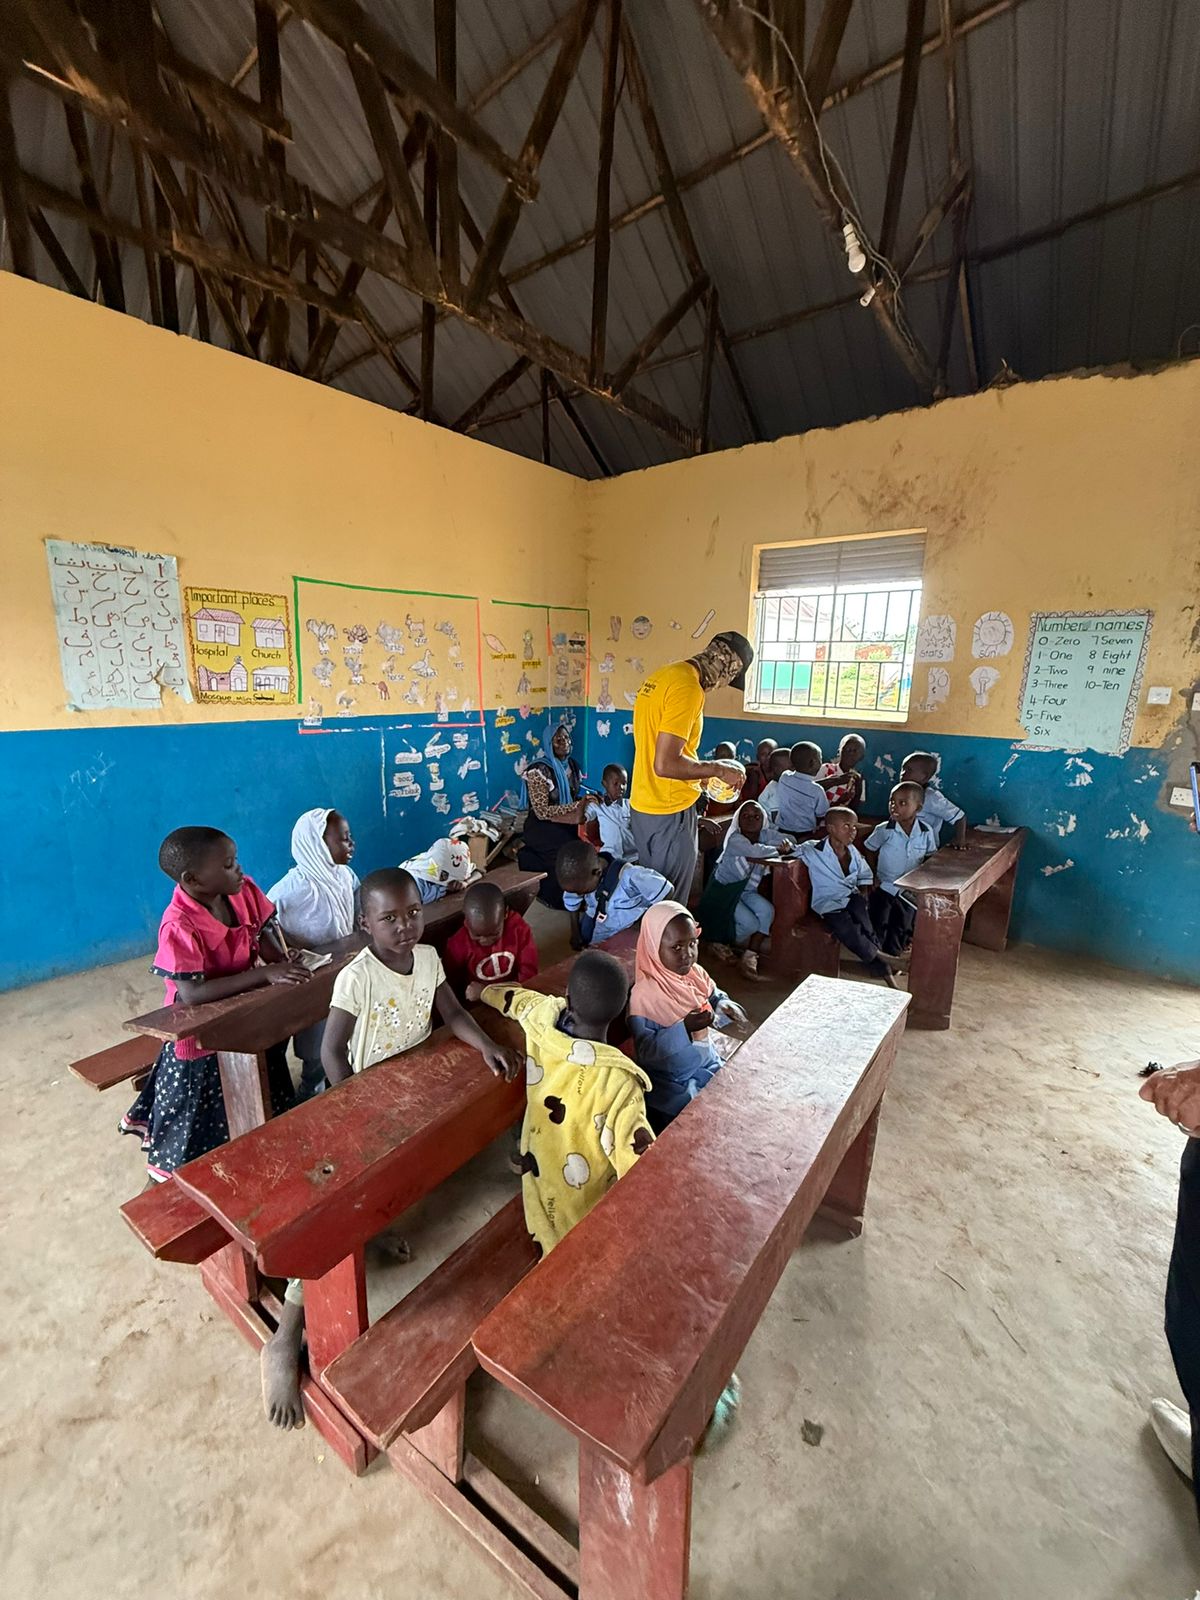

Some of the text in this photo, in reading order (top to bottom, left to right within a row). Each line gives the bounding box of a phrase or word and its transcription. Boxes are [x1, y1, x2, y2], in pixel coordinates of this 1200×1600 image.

[191, 589, 275, 610] Important places
[1095, 620, 1145, 631] names
[192, 644, 282, 660] Hospital Church
[1102, 650, 1132, 664] Eight
[1102, 667, 1127, 676] nine
